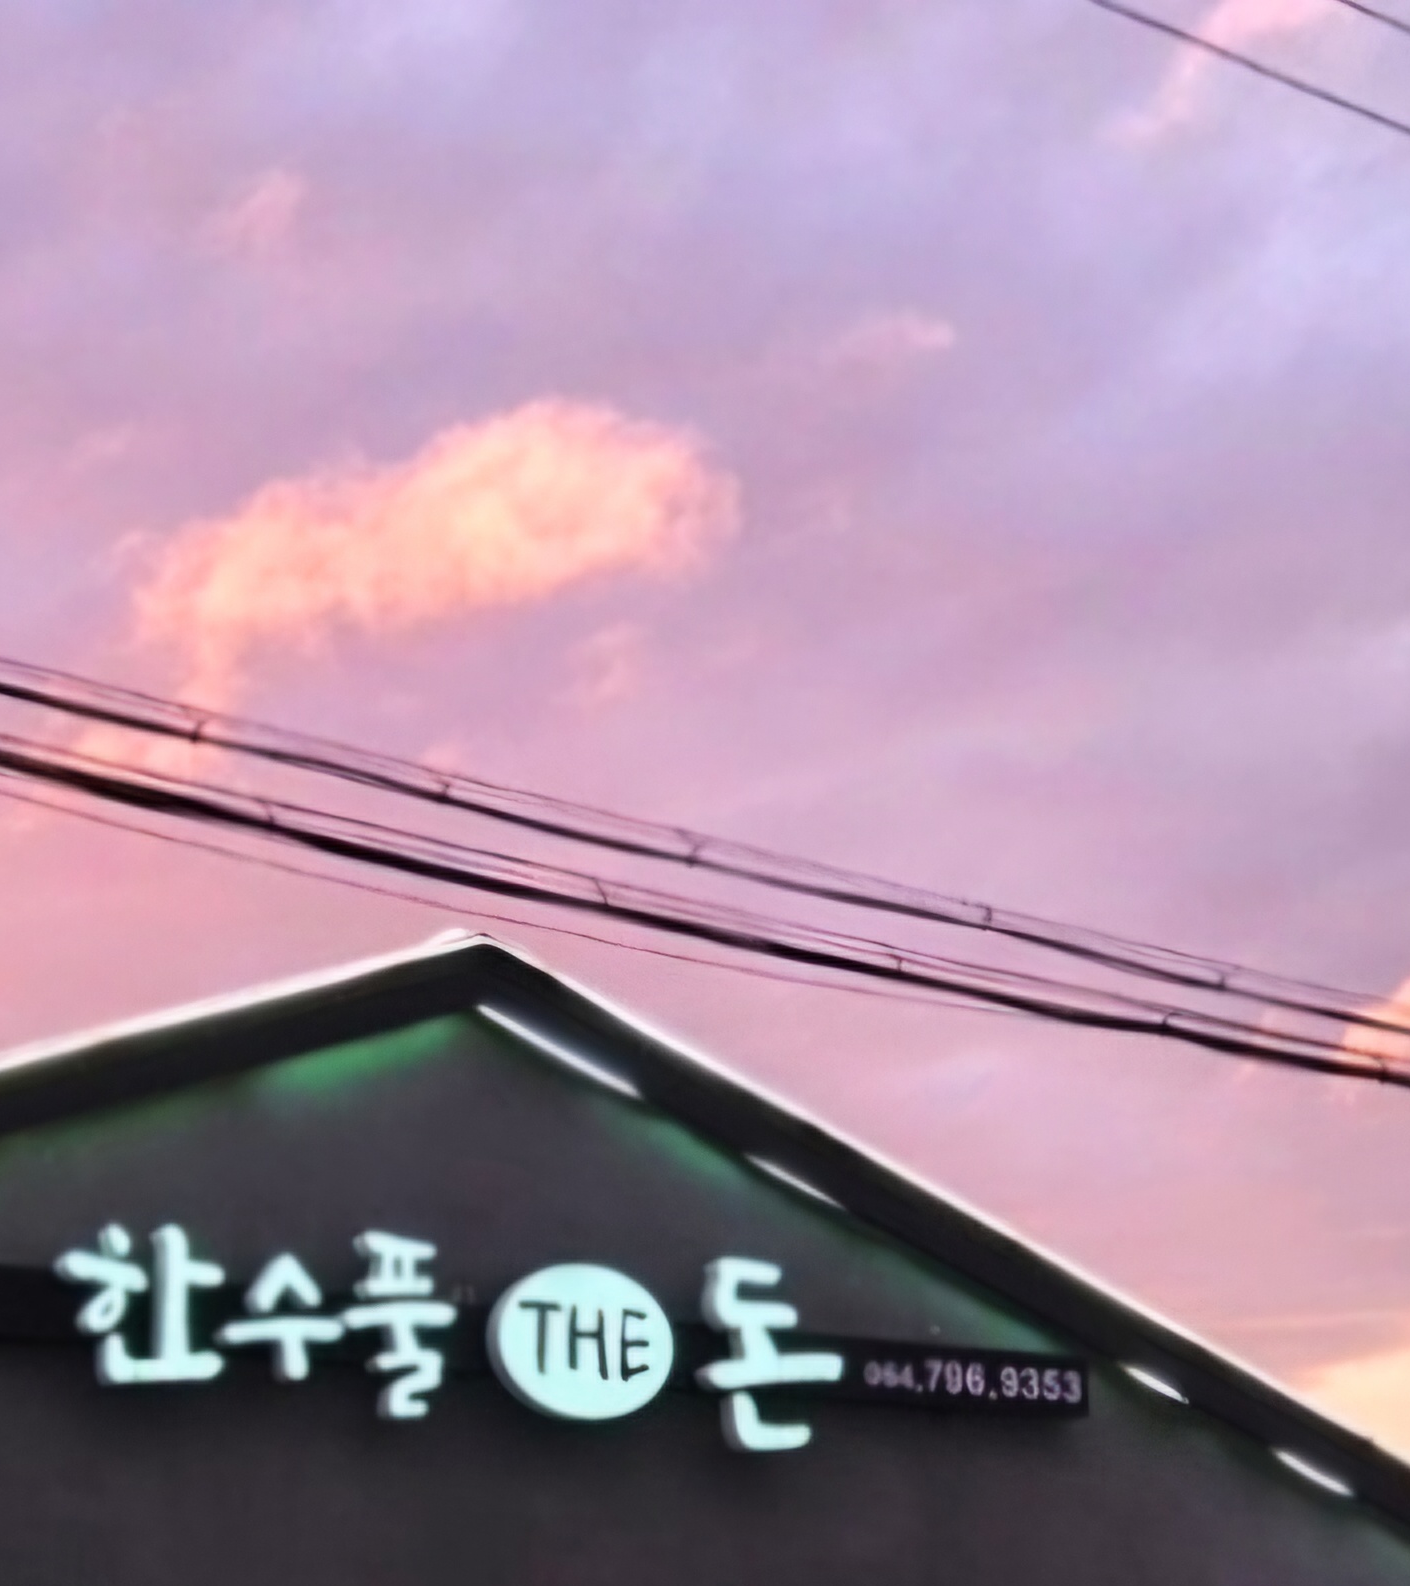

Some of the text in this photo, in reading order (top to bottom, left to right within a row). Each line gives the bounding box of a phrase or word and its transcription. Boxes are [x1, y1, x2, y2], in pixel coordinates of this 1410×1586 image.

[55, 1223, 844, 1452] 한수풀 THE 돈
